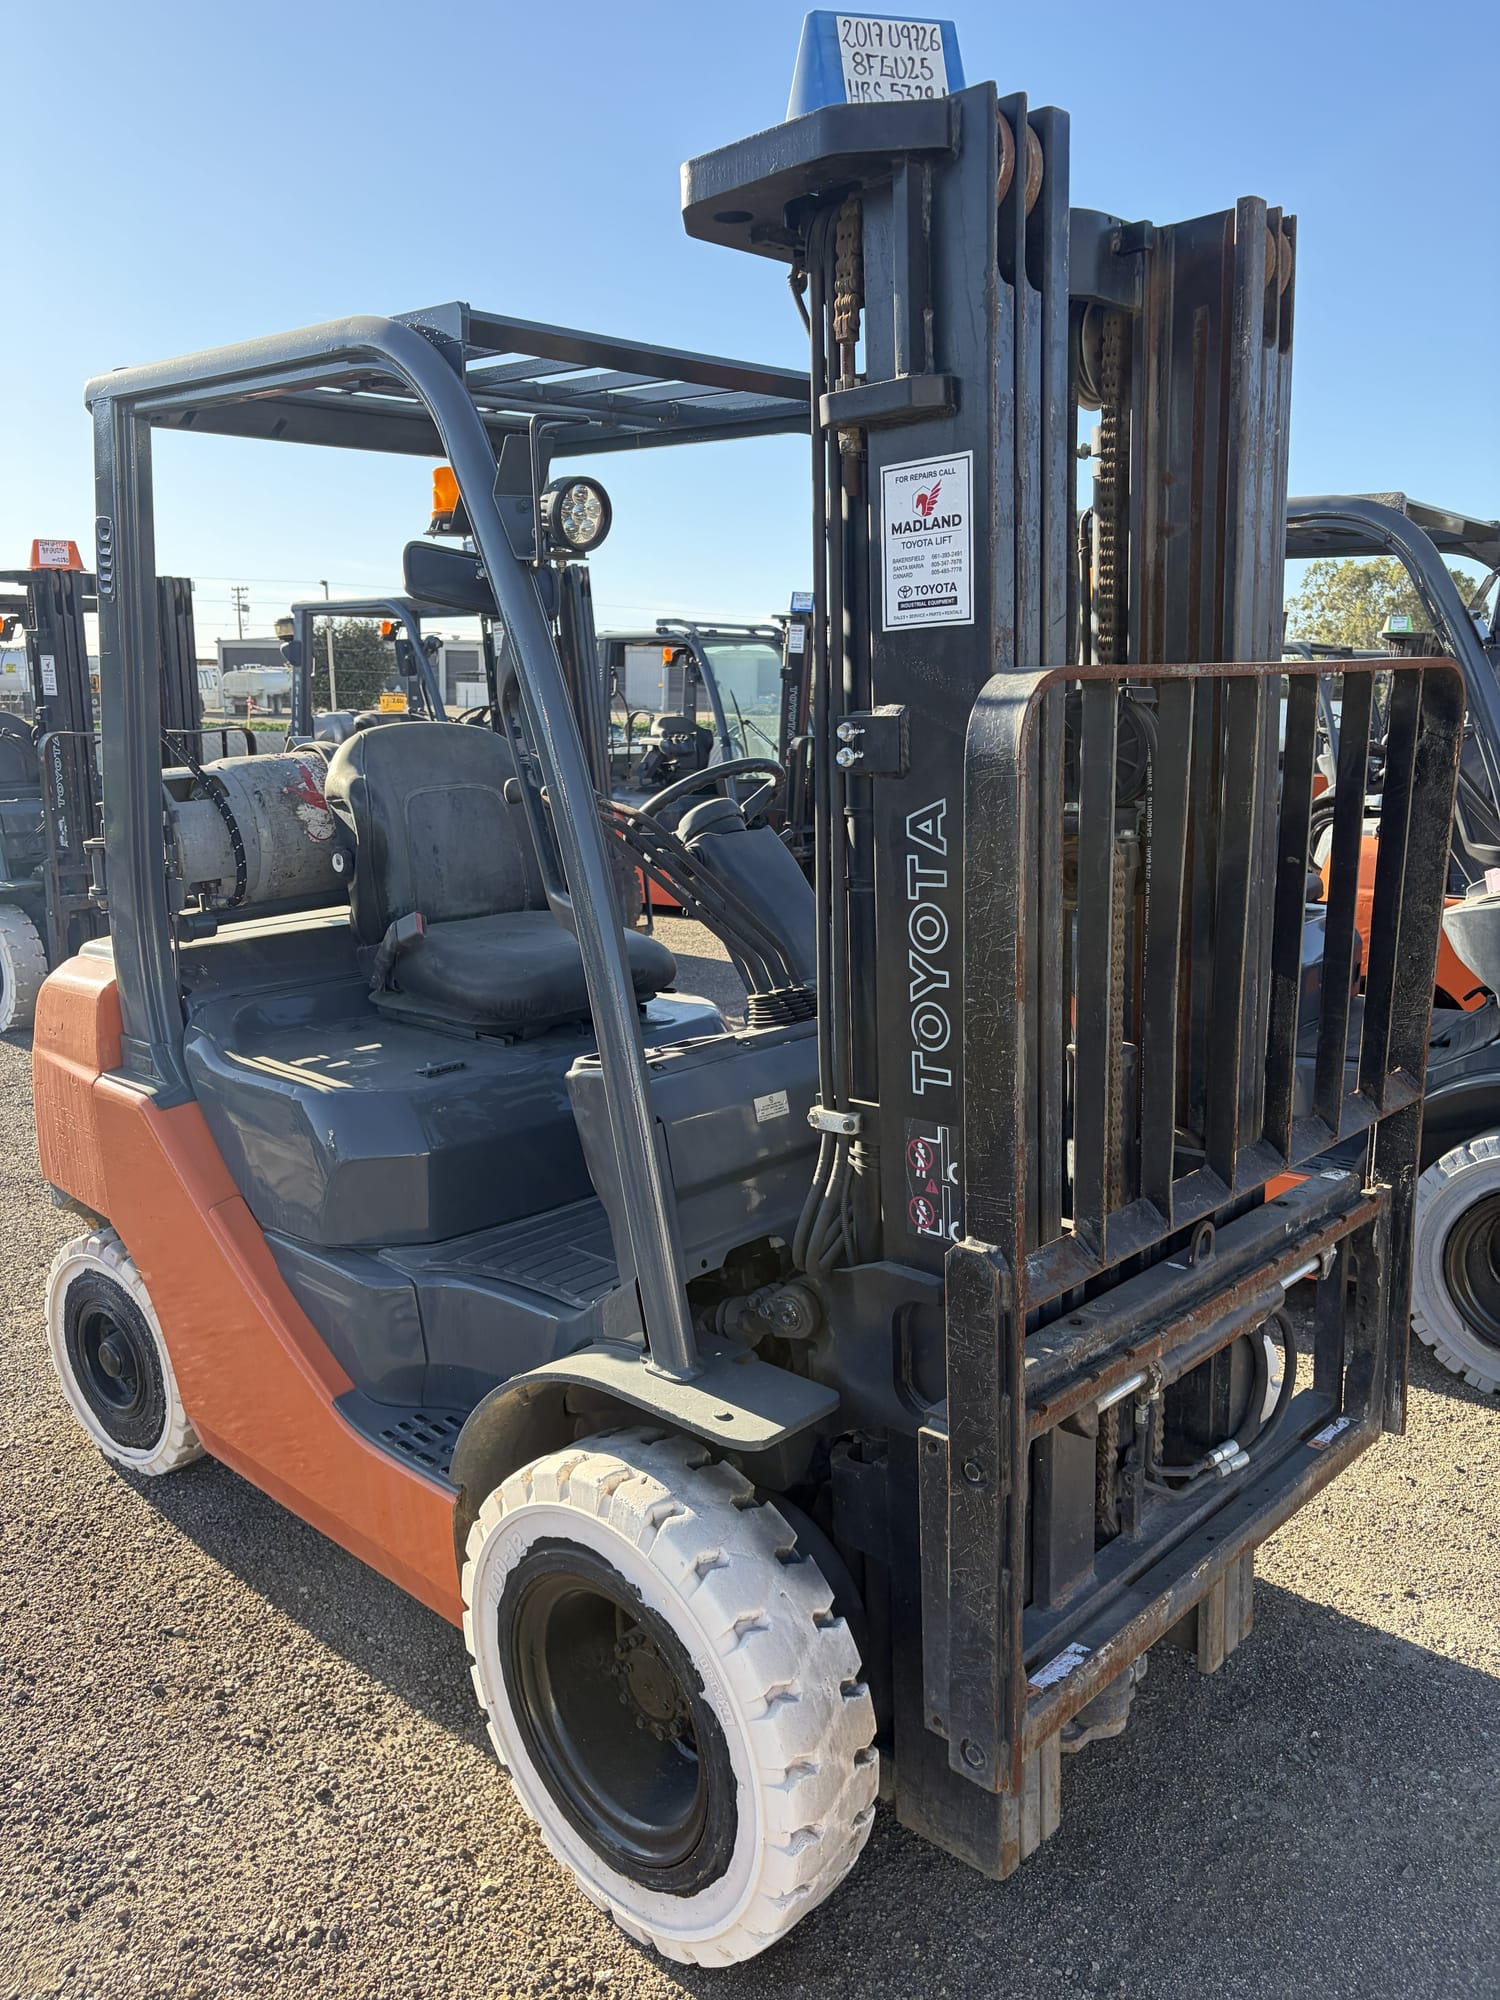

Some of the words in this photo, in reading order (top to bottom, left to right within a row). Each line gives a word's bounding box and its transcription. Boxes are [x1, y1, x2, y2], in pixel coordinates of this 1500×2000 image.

[841, 19, 883, 48] 2017
[888, 23, 942, 52] U9726
[852, 51, 934, 81] 8FGU25
[847, 78, 883, 104] HRS
[895, 476, 909, 484] FOR
[910, 470, 937, 482] REPAIRS
[938, 467, 956, 477] CALL
[891, 514, 962, 536] MADLAND
[901, 538, 934, 550] TOYOTA
[935, 535, 953, 546] LIFT
[893, 564, 908, 572] SANTA
[914, 582, 958, 596] TOYOTA
[900, 600, 927, 609] INDUSTRIAL
[927, 597, 955, 606] EQUIPMENT
[906, 798, 952, 1096] TOYOTA
